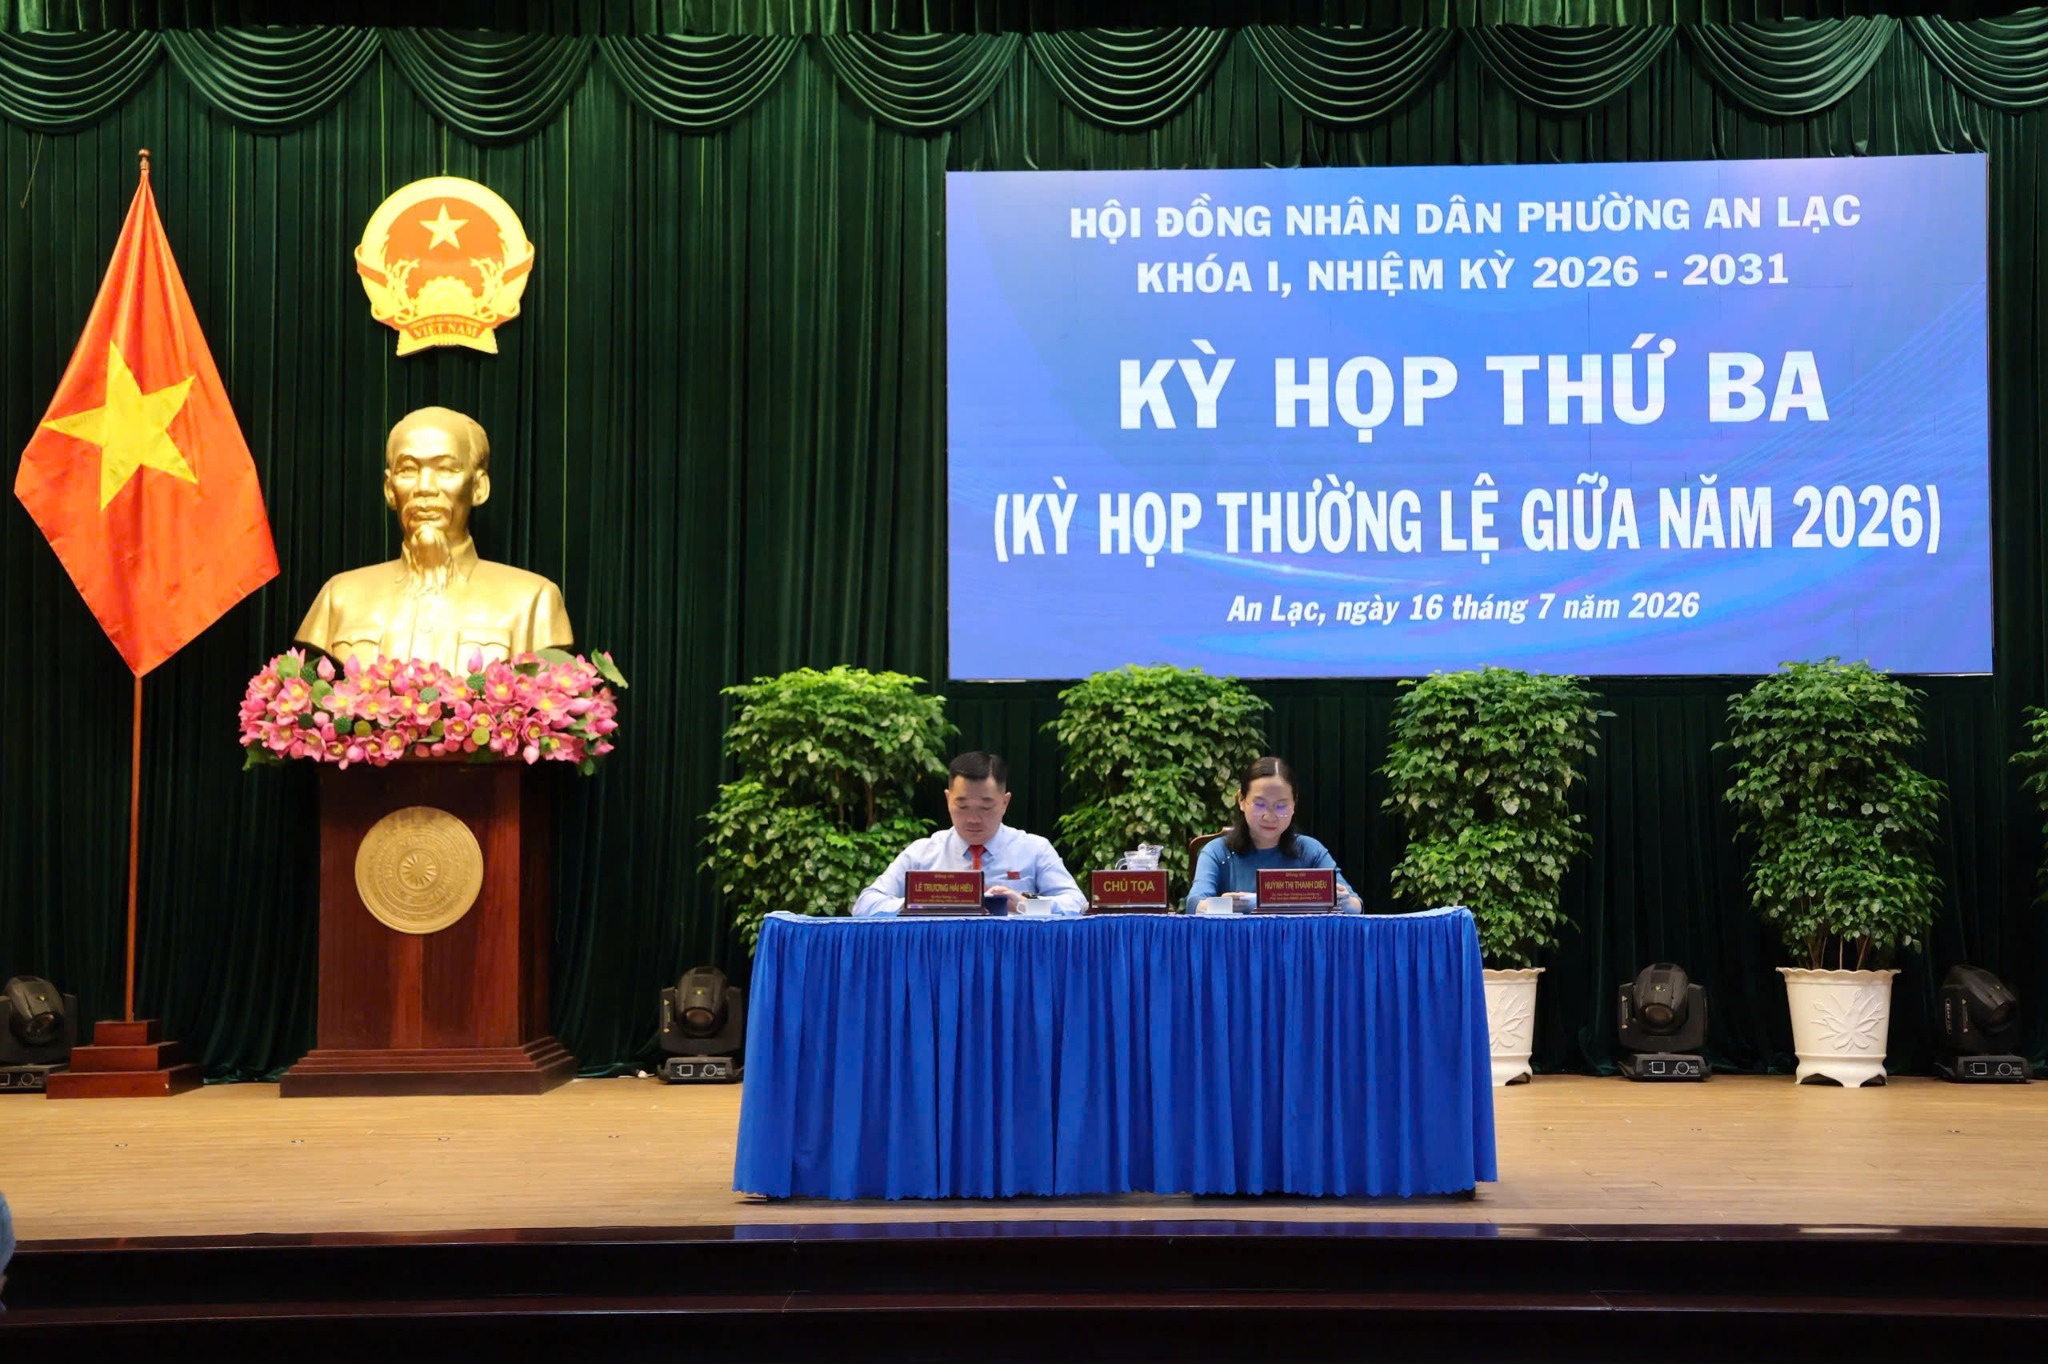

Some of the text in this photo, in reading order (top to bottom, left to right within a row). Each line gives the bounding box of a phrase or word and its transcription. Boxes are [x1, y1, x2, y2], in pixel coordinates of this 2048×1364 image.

[1070, 192, 1860, 245] HỘI ĐỒNG NHÂN DÂN PHƯỜNG AN LẠC
[1138, 251, 1789, 299] KHÓA I, NHIỆM KỲ 2026 - 2031
[447, 322, 478, 338] NAM
[1120, 332, 1829, 443] KỲ HỌP THỨ BA
[994, 472, 1941, 567] (KỲ HỌP THƯỜNG LỆ GIỮA NĂM 2026)
[1227, 592, 1700, 627] An Lạc, ngày 16 tháng 7 năm 2026
[1103, 878, 1155, 894] CHỦ TỌA
